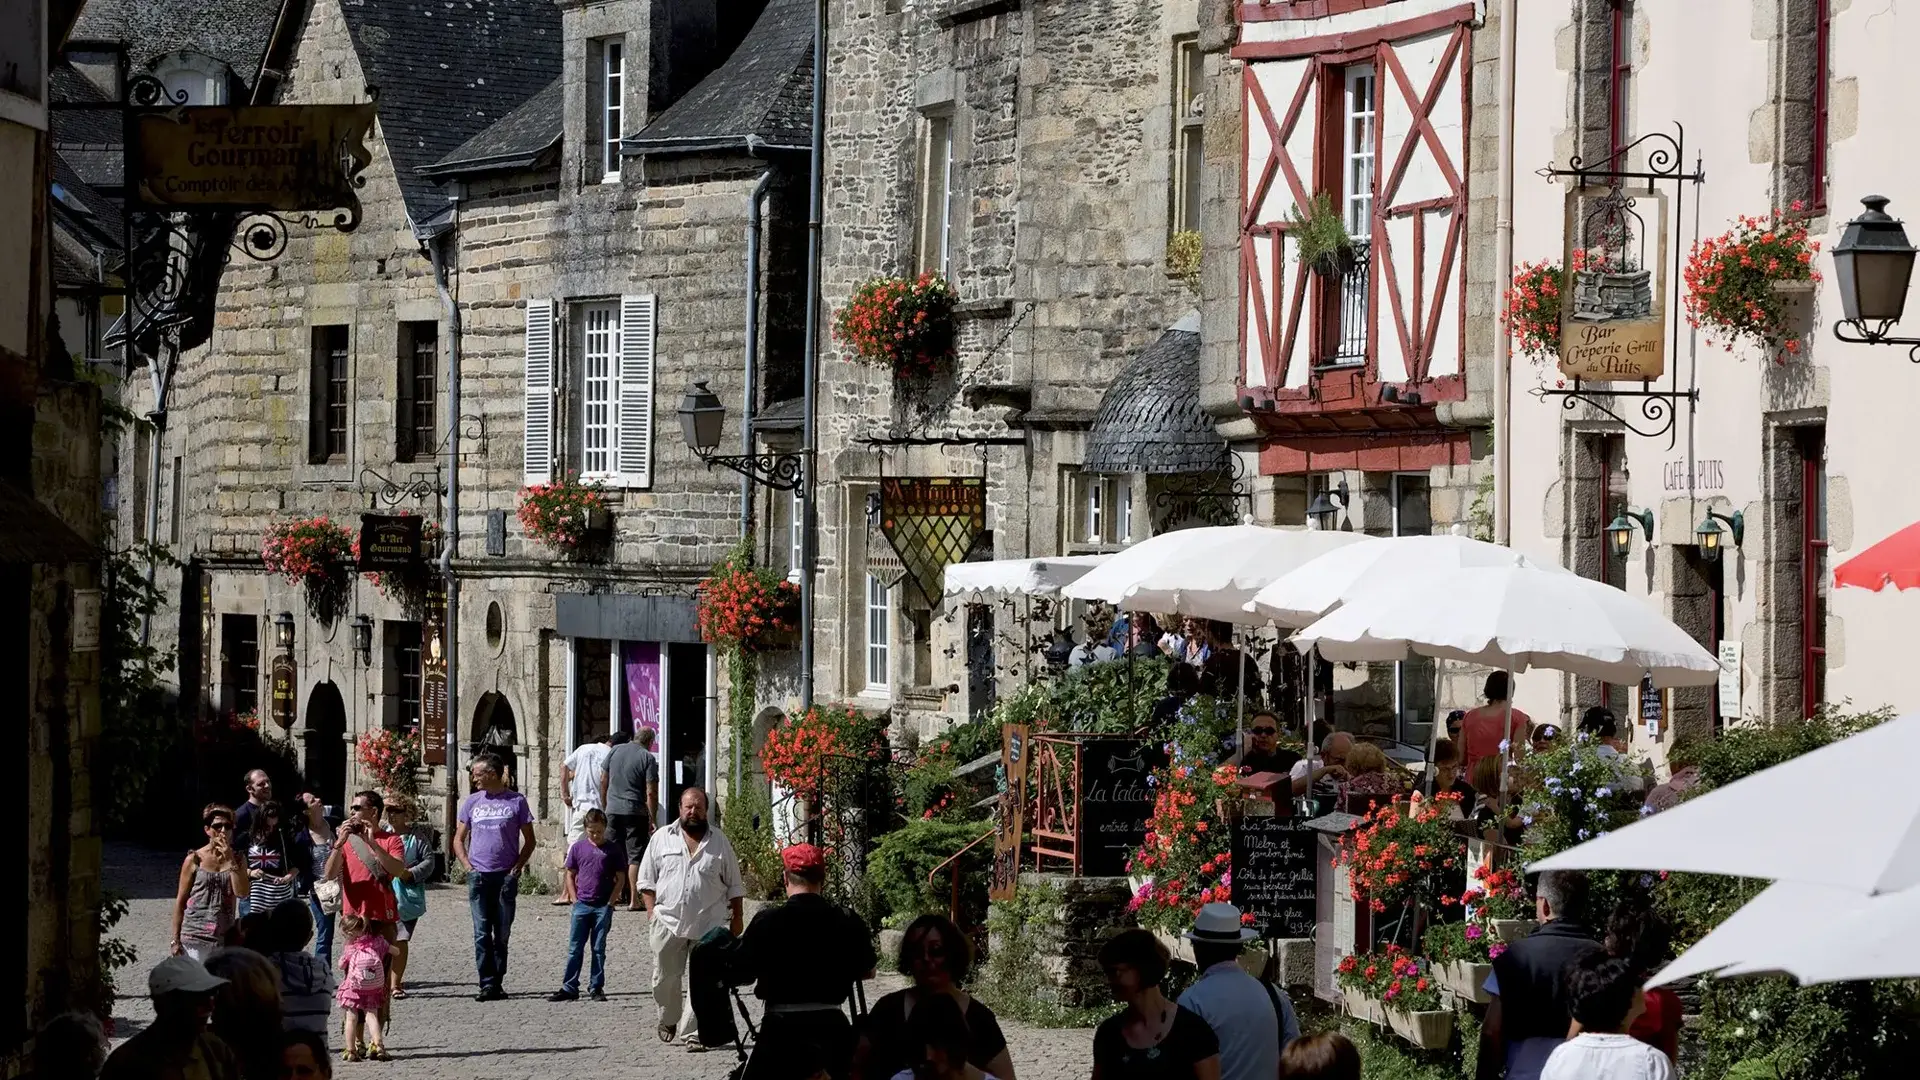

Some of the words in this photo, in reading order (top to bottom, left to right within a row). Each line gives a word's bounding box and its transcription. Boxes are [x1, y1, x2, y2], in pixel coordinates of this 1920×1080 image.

[211, 118, 304, 146] Terroir
[165, 175, 238, 197] Comptoir
[1580, 325, 1616, 346] Bar
[1626, 340, 1658, 356] Grill
[1586, 361, 1598, 373] du
[1600, 355, 1641, 375] Puits
[1663, 455, 1684, 491] CAFÉ
[1697, 460, 1724, 490] PUITS
[369, 542, 412, 554] Gourmand
[1084, 779, 1108, 803] La
[1099, 819, 1129, 832] entrée
[1240, 816, 1261, 831] La
[1243, 834, 1278, 849] Melon
[1280, 837, 1291, 849] et
[1248, 848, 1284, 866] jambon
